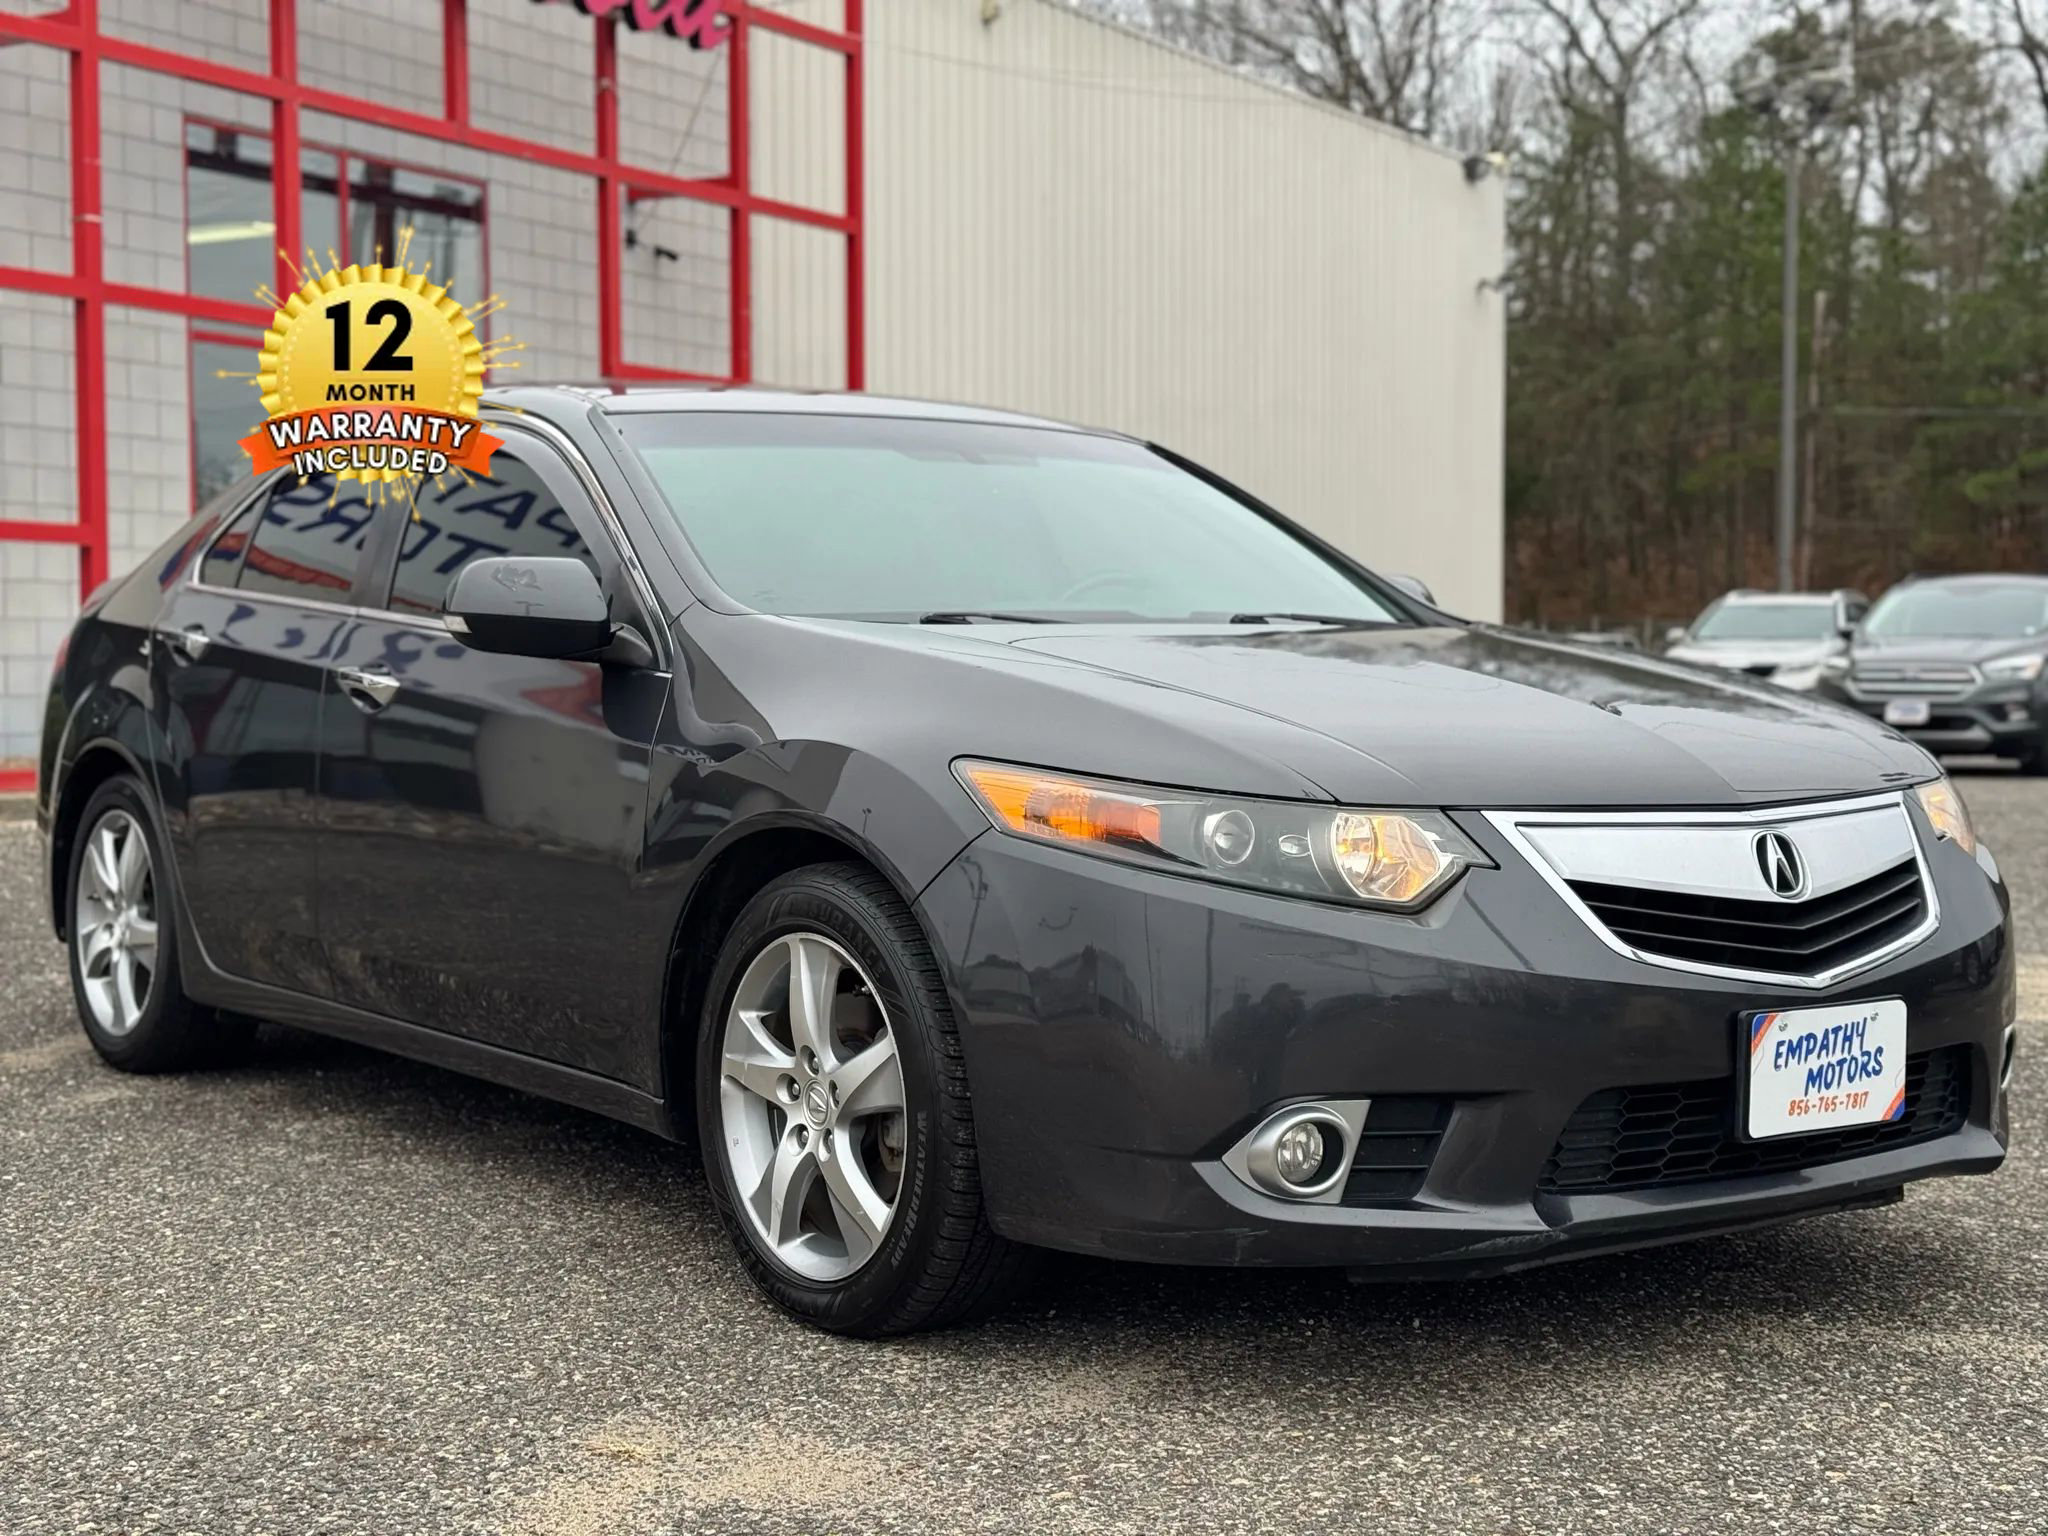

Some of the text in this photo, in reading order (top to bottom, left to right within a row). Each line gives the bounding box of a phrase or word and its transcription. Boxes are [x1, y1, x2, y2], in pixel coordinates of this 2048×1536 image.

[1774, 1016, 1868, 1072] EMPATHY
[1804, 1045, 1884, 1098] MOTORS
[1788, 1091, 1869, 1117] 856-765-7817
